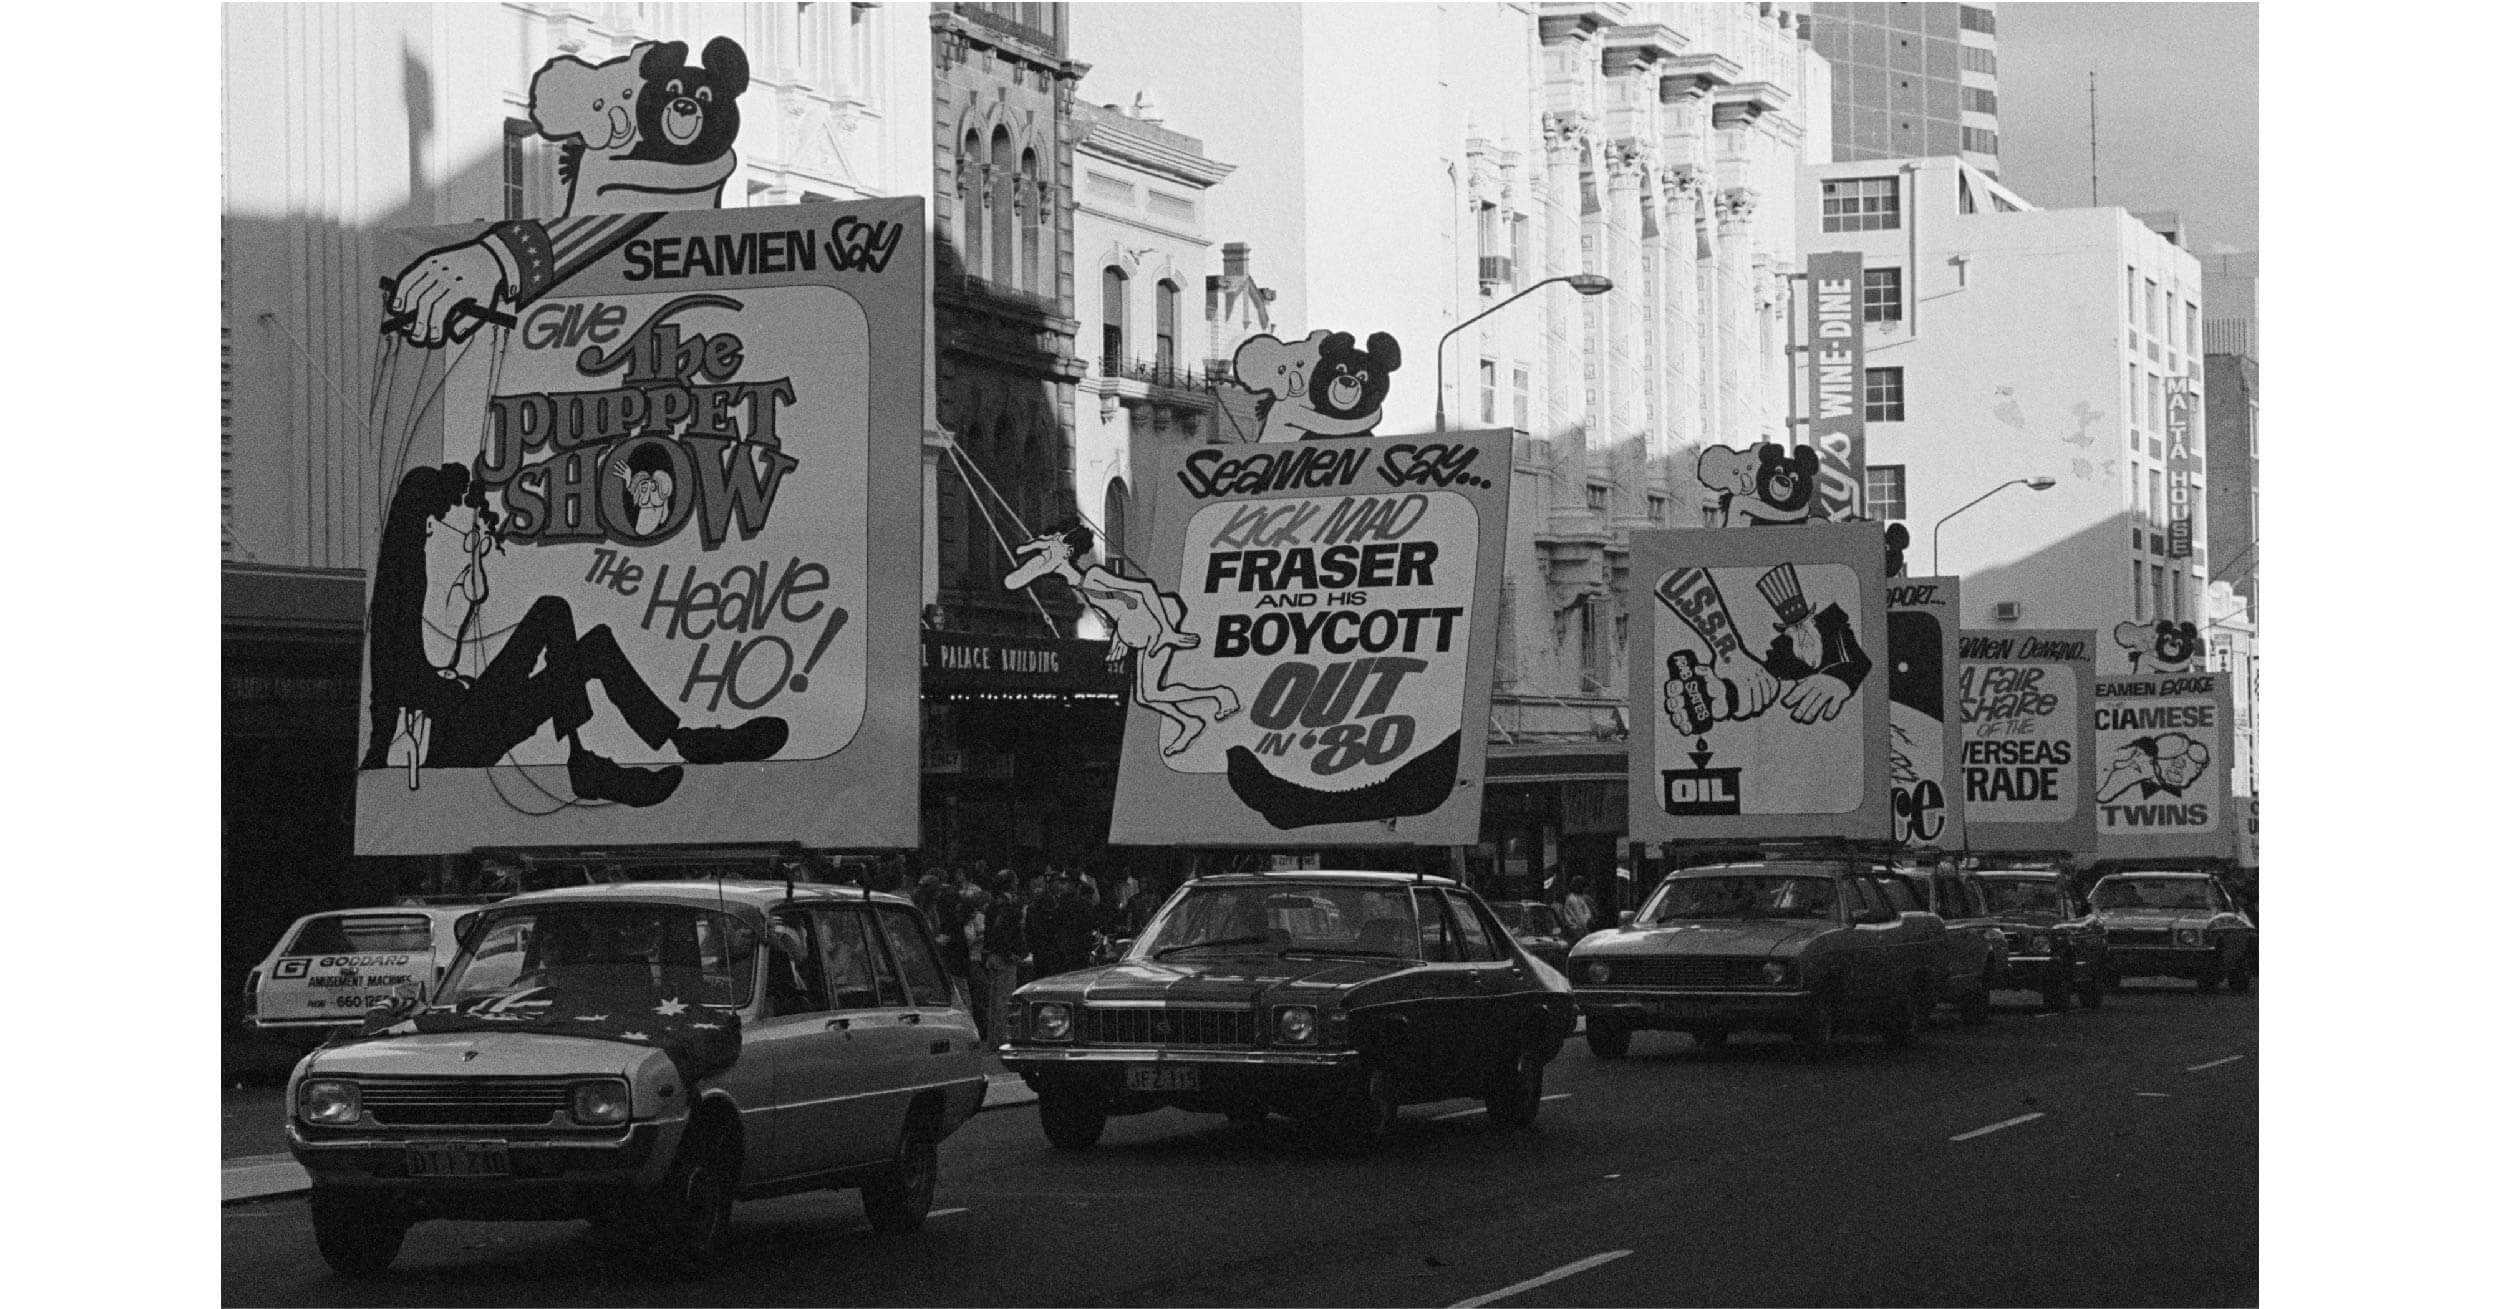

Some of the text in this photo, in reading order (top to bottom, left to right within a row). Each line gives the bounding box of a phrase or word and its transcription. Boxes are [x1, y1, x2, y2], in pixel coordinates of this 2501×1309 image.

[623, 229, 816, 281] SEAMEN
[2167, 377, 2189, 460] MALTA
[502, 433, 798, 550] SHOW
[1210, 494, 1428, 548] KICK MAD
[2171, 471, 2189, 555] HOUSE
[1204, 541, 1439, 593] FRASER
[1254, 590, 1368, 609] AND HIS
[1213, 607, 1464, 658] BOYCOTT
[679, 607, 849, 712] HO!
[941, 645, 991, 669] PALACE
[1002, 648, 1059, 672] BUILDING
[1250, 656, 1429, 731] OUT
[2095, 682, 2156, 697] EAMEN
[2095, 705, 2216, 730] CIAMESE
[1254, 732, 1297, 756] IN
[1671, 778, 1736, 803] OIL
[1962, 767, 2059, 802] RADE
[2100, 803, 2208, 827] TWINS
[320, 956, 409, 967] GODDARD
[308, 976, 363, 987] AMUSEMENT
